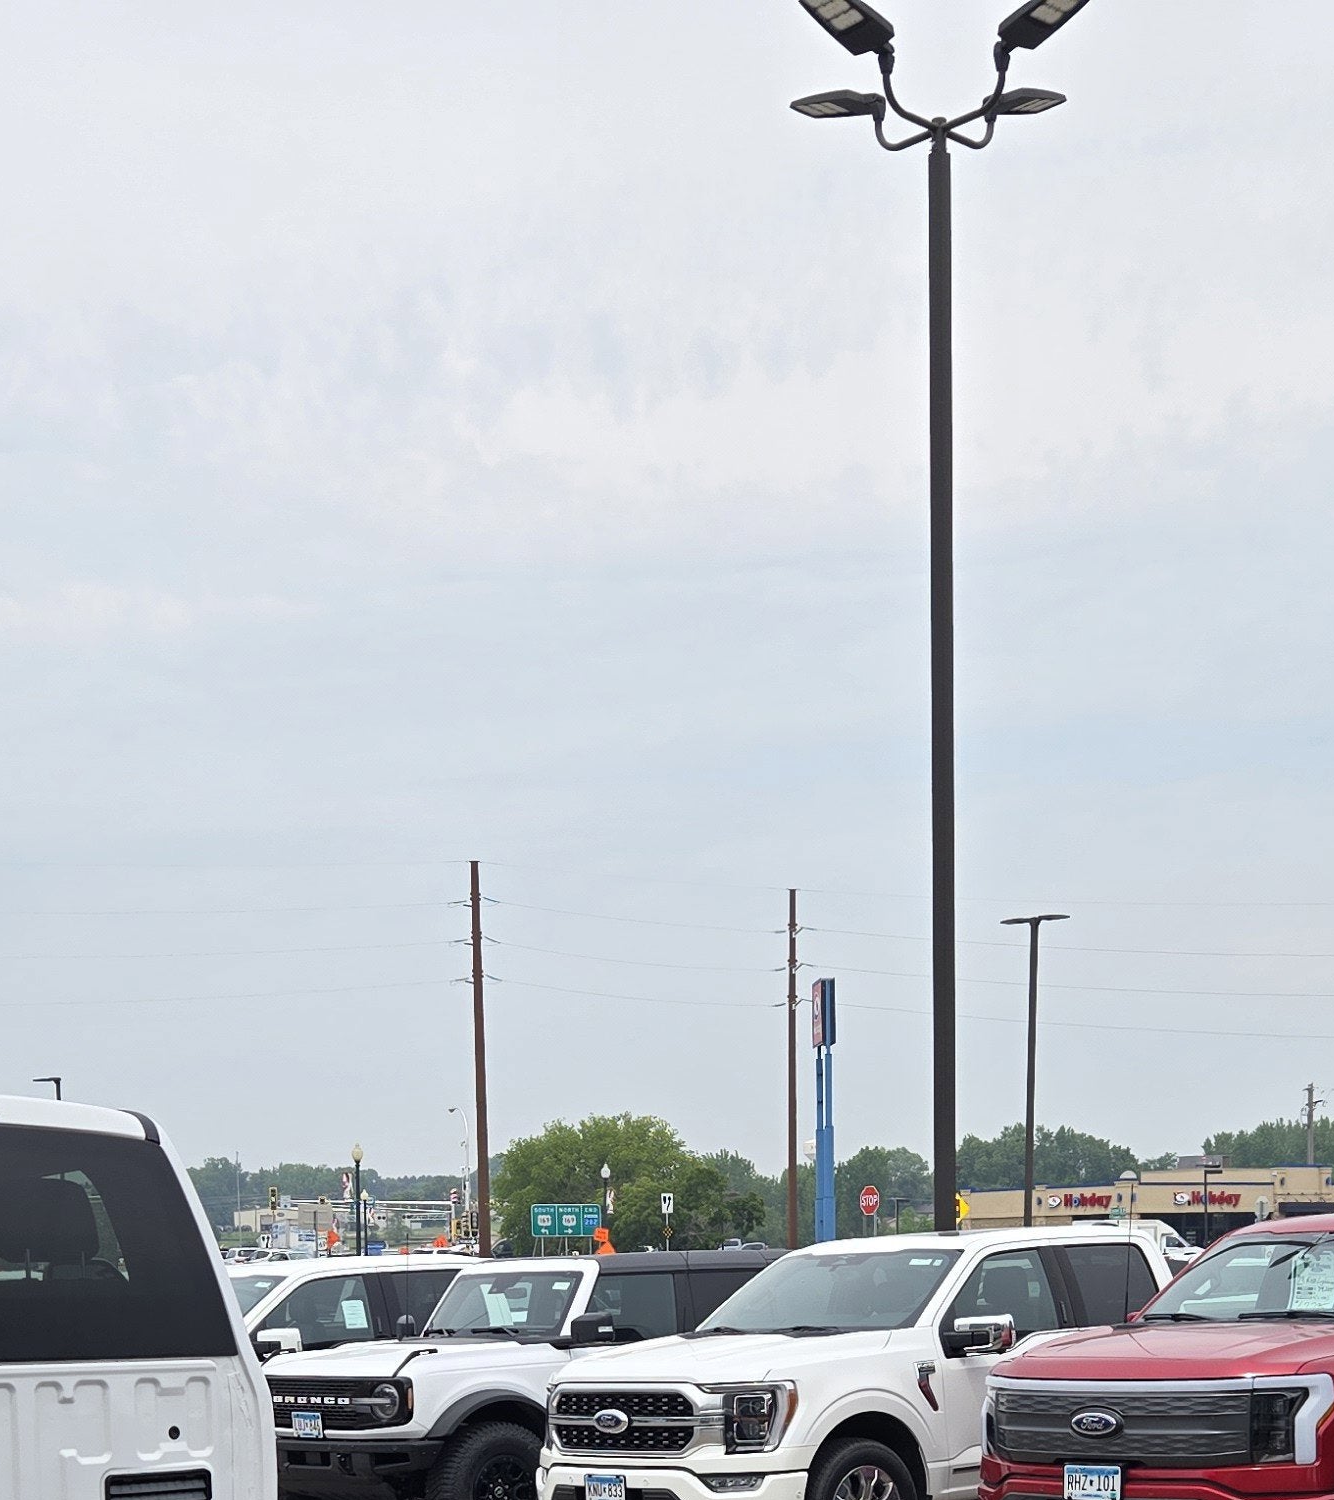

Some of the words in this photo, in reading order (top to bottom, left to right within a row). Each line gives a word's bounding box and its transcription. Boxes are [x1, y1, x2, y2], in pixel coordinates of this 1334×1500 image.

[862, 1195, 878, 1207] STOP
[1063, 1193, 1112, 1208] Holiday
[273, 1396, 350, 1404] BRONCO
[1081, 1417, 1104, 1429] Ford
